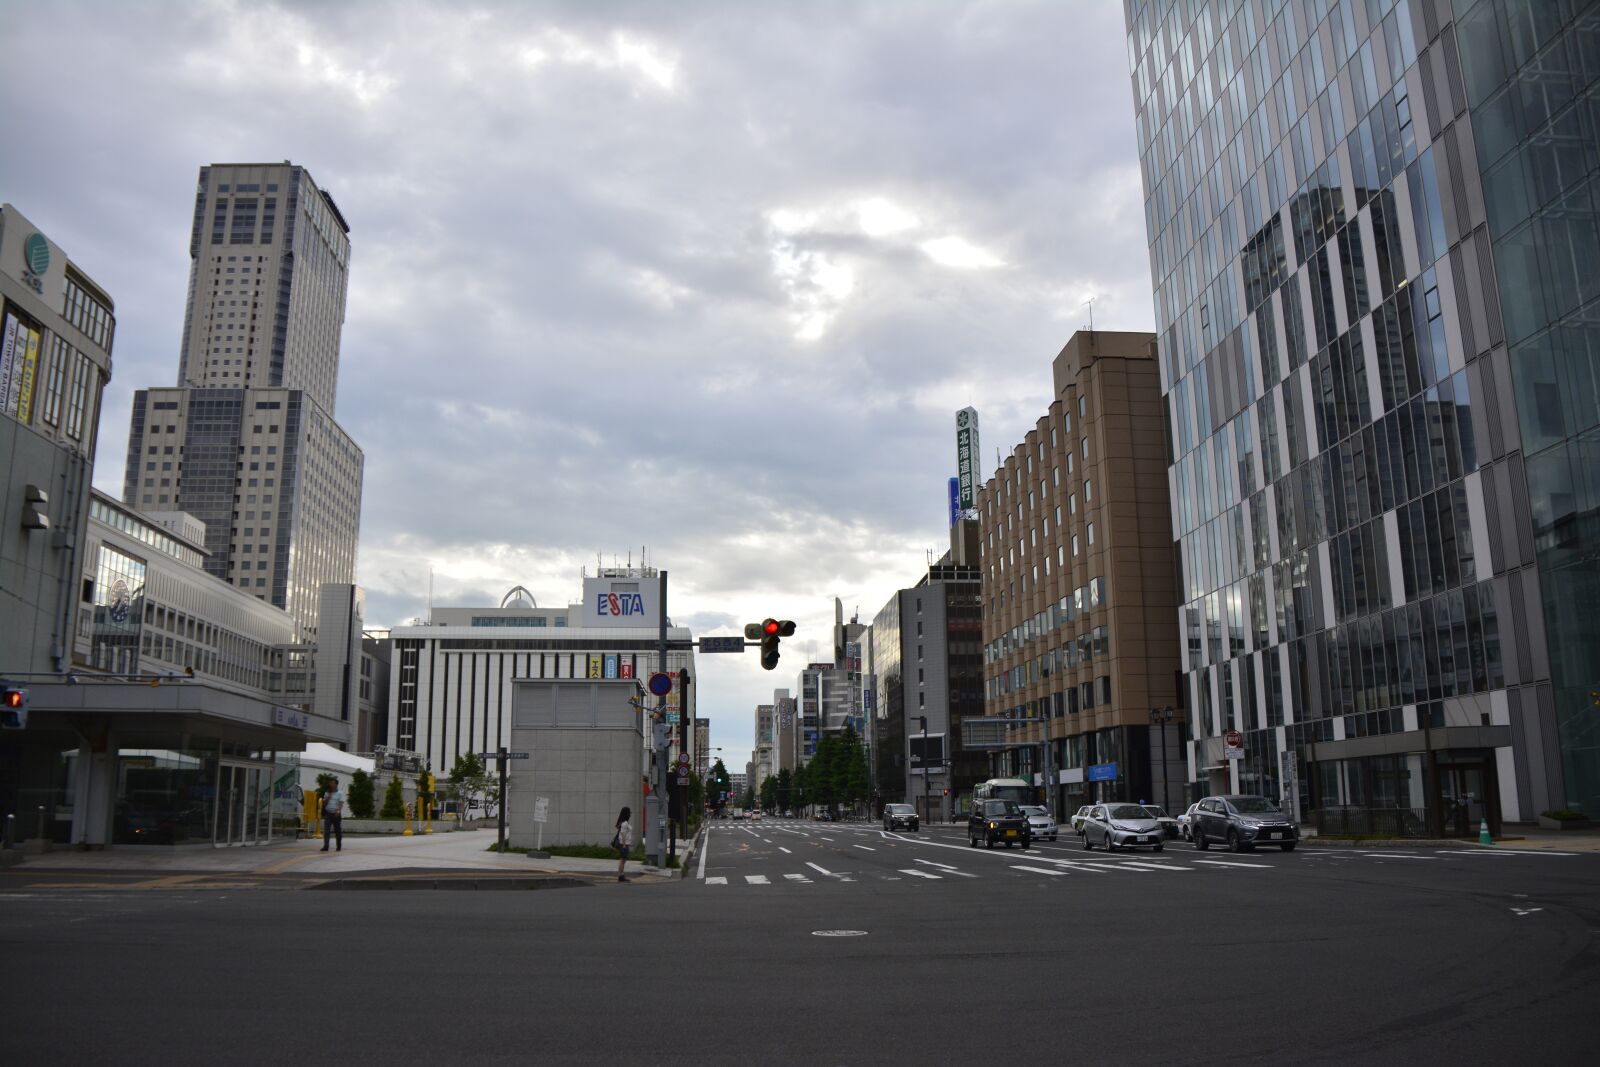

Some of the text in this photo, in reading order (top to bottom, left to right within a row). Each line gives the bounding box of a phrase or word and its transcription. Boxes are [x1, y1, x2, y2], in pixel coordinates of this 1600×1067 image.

[4, 340, 14, 370] TOWER
[960, 432, 972, 502] 北海道銀行
[597, 592, 645, 617] ESTA
